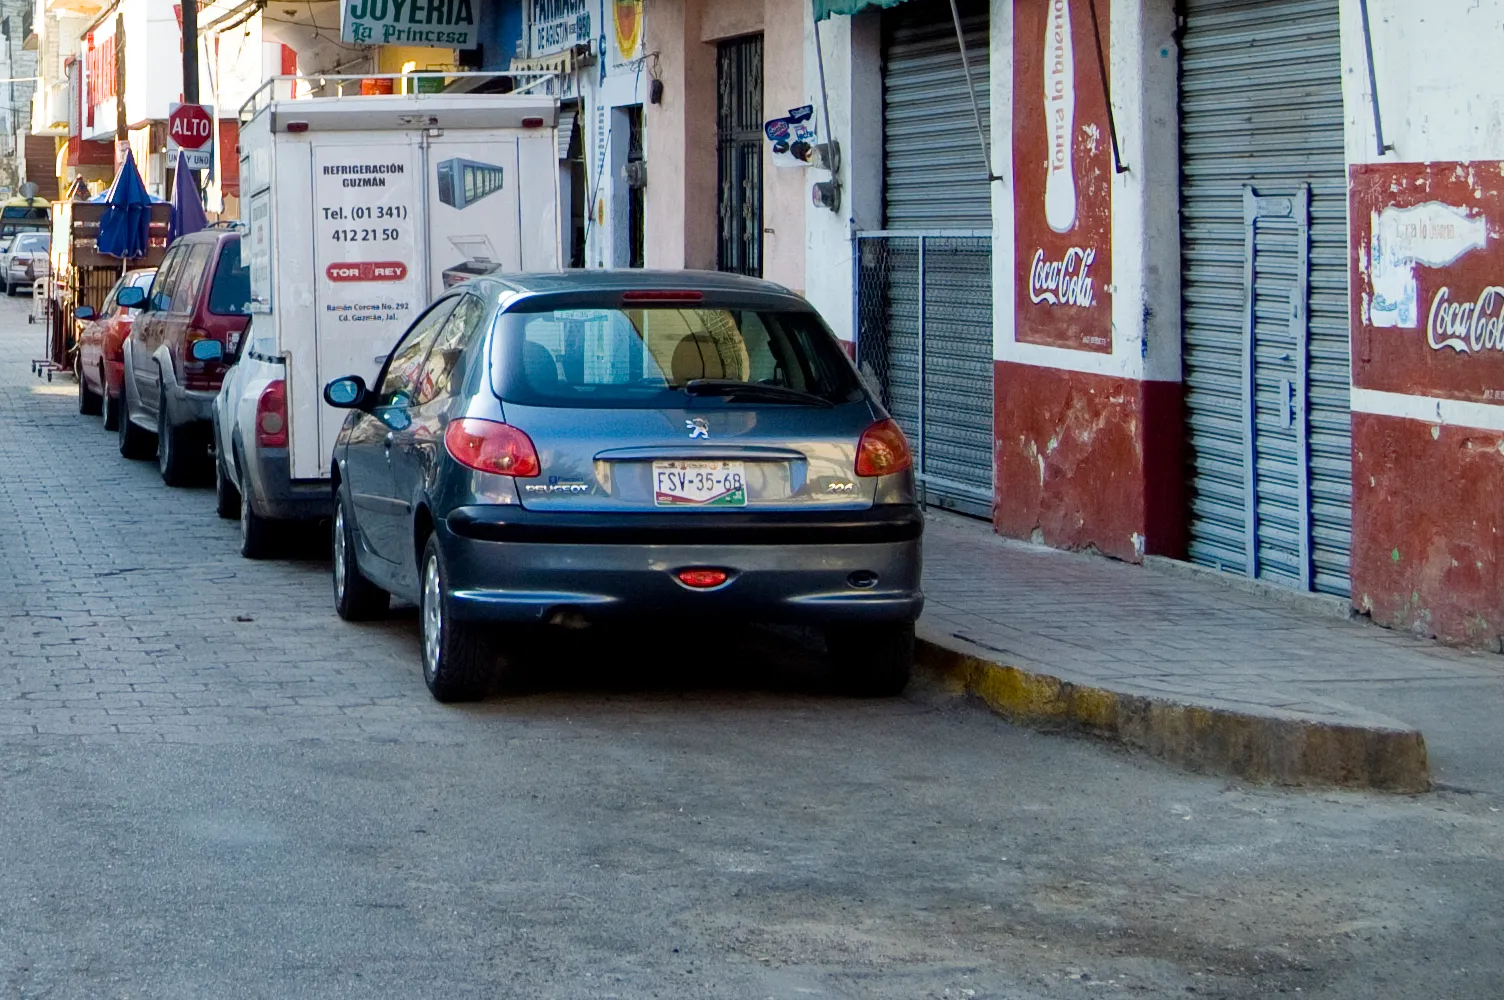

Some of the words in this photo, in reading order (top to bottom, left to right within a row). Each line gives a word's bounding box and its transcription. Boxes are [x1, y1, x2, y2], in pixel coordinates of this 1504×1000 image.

[351, 22, 373, 43] La
[383, 25, 468, 44] Princesa
[537, 27, 544, 50] DE
[172, 117, 209, 136] ALTO
[194, 156, 209, 165] UNO
[323, 163, 404, 175] REFRIGERACIÓN
[342, 176, 385, 187] GUZMÁN
[323, 207, 348, 220] Tel.
[351, 206, 371, 220] (01
[377, 205, 407, 220] 341)
[332, 230, 357, 242] 412
[362, 229, 377, 241] 21
[382, 228, 399, 241] 50
[1029, 247, 1097, 308] Coca-Cola
[395, 302, 409, 310] 292
[658, 472, 742, 492] FSV-35-68
